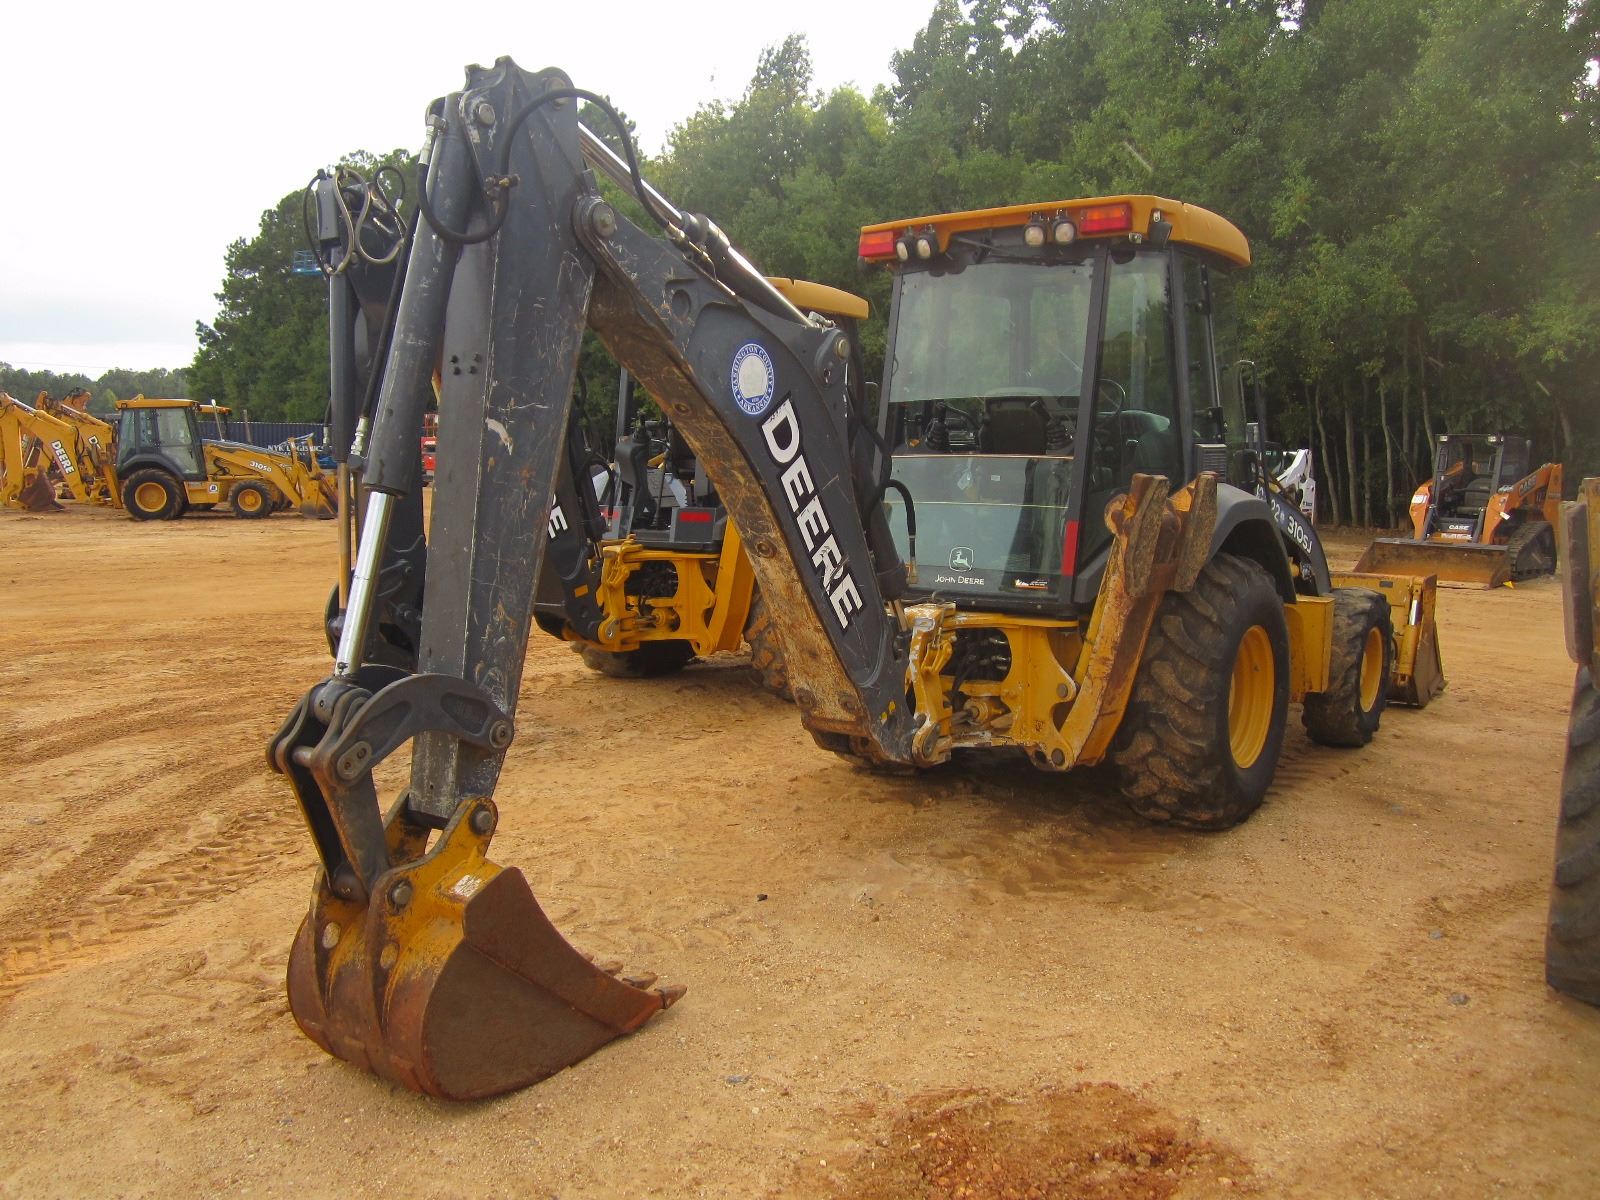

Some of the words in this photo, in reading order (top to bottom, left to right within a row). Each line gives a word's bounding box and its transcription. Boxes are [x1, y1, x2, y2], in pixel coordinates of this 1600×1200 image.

[758, 348, 774, 386] COUNTY
[739, 394, 770, 413] ARKANSAS
[51, 440, 75, 474] DEERE
[761, 398, 864, 630] DEERE
[1287, 515, 1313, 554] 310SJ
[934, 574, 956, 584] JOHN
[957, 576, 985, 586] DEERE
